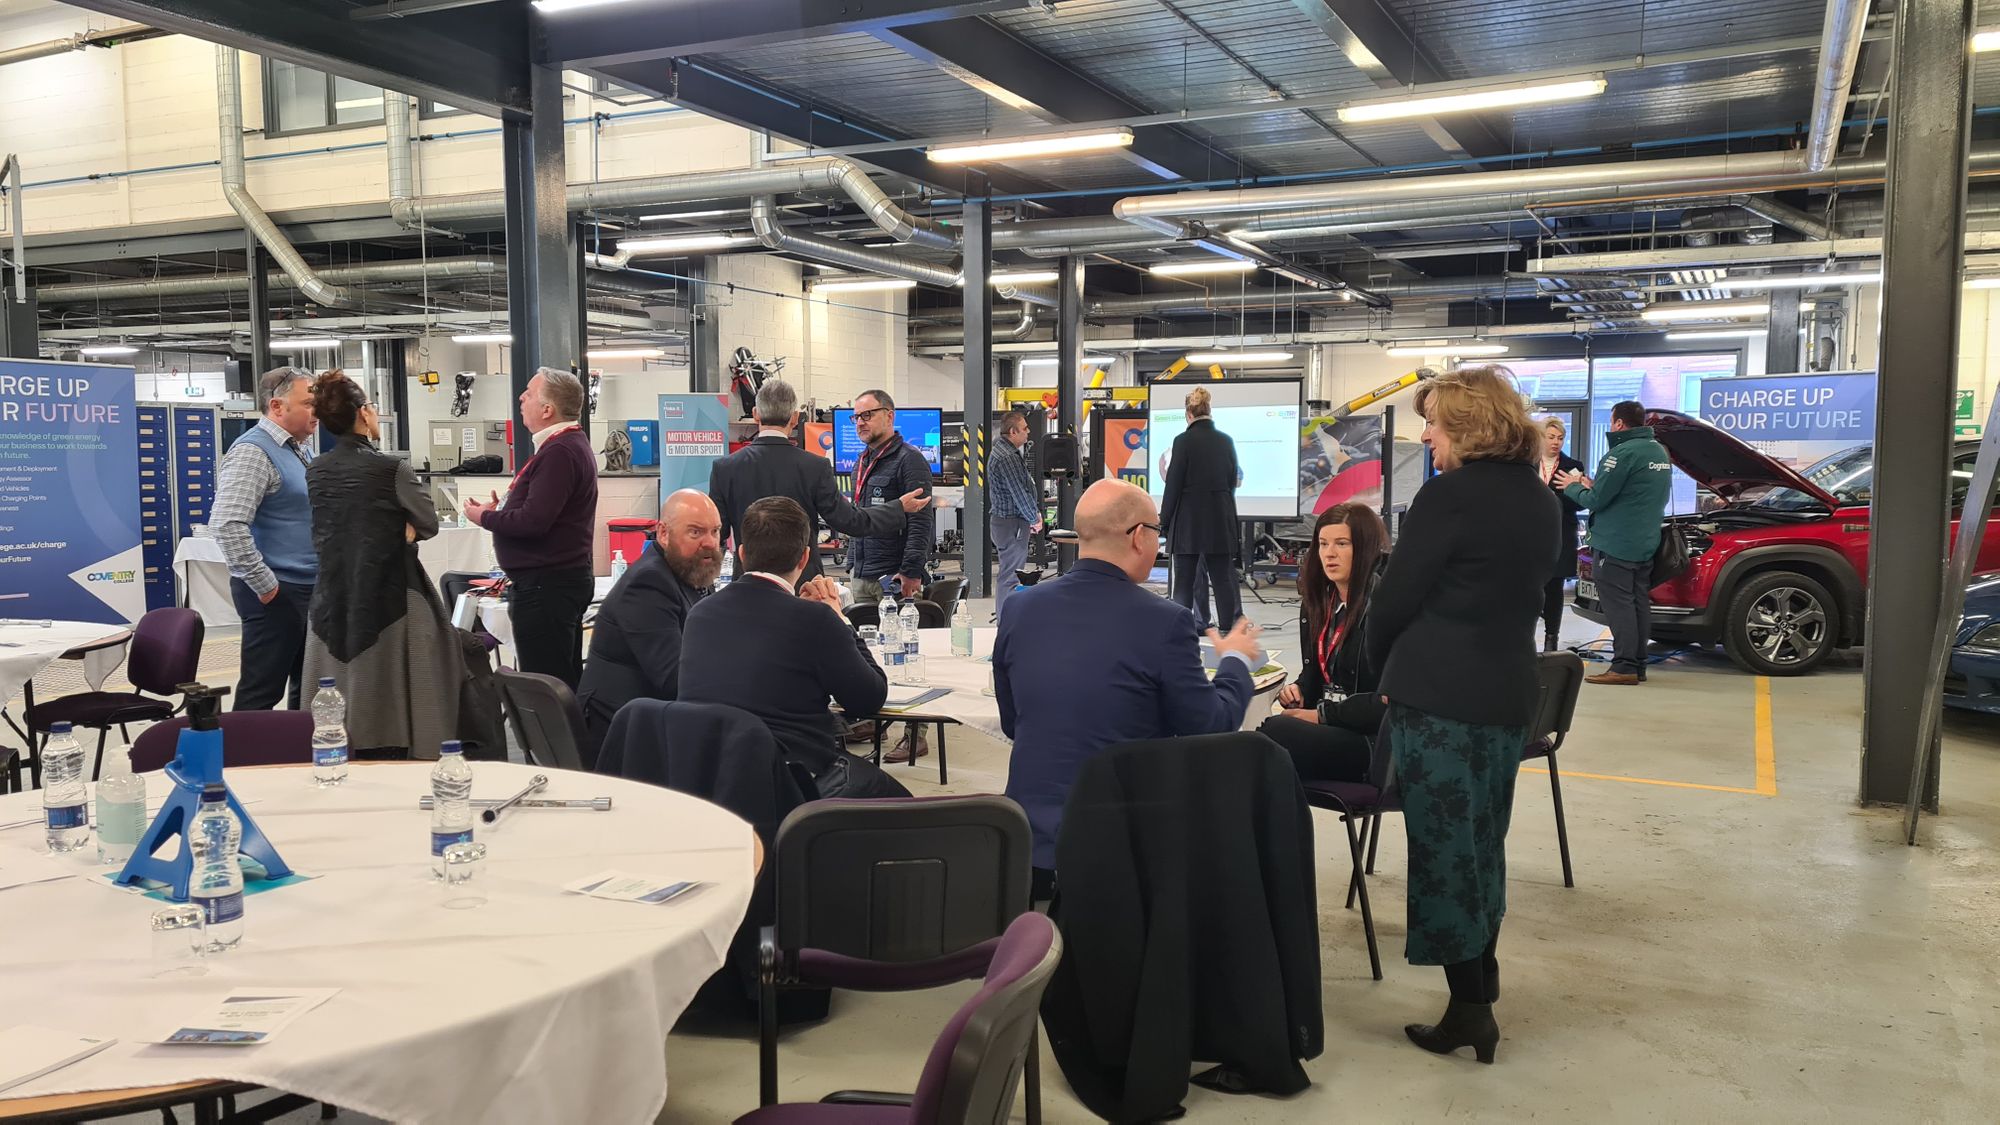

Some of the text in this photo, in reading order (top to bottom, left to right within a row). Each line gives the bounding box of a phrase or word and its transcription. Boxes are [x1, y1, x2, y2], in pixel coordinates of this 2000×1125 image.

[0, 375, 90, 397] RGE UP
[1709, 388, 1834, 408] CHARGE UP
[25, 402, 120, 424] FUTURE
[1708, 410, 1861, 430] YOUR FUTURE
[667, 432, 722, 442] MOTOR VEHICLE
[675, 445, 698, 454] MOTOR
[700, 445, 722, 454] SPORT
[87, 570, 136, 582] COVENTRY
